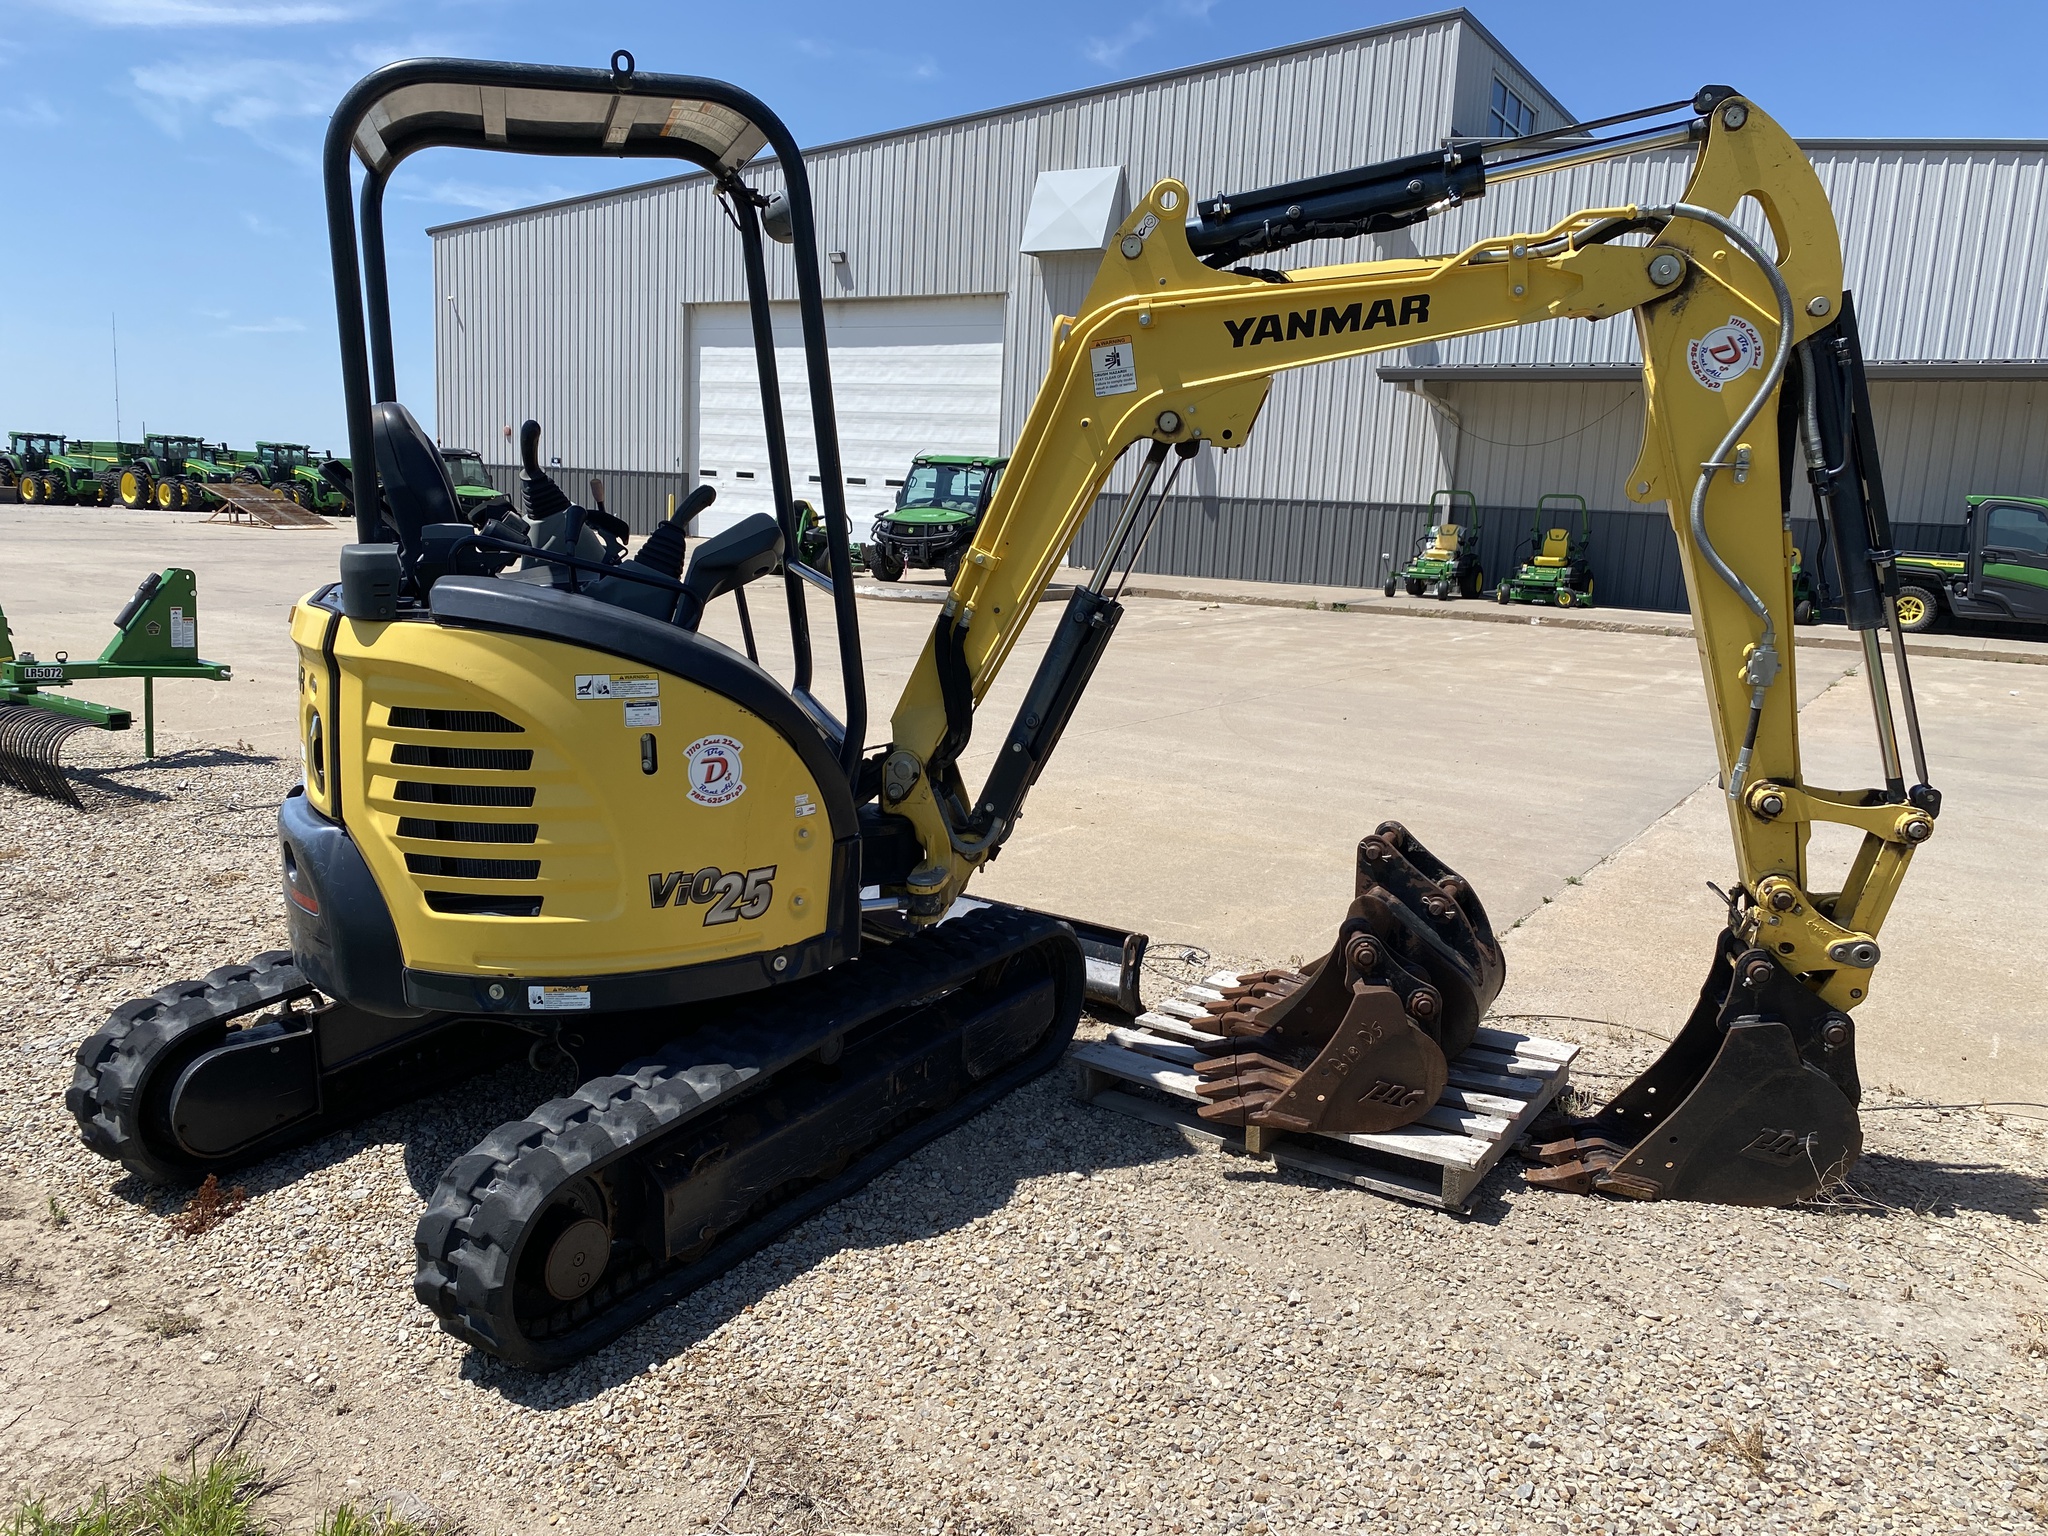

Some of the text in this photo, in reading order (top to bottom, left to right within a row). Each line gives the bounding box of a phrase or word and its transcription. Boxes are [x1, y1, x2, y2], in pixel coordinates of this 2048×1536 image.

[1223, 294, 1430, 348] YANMAR
[1100, 338, 1126, 346] WARNING
[1746, 328, 1759, 344] East
[1737, 334, 1749, 354] Big
[1700, 346, 1721, 378] Rent All
[1752, 345, 1762, 367] 22nd
[25, 667, 63, 679] LR5072
[704, 747, 724, 757] Big
[722, 738, 741, 752] 22nd
[699, 780, 734, 795] Rent All
